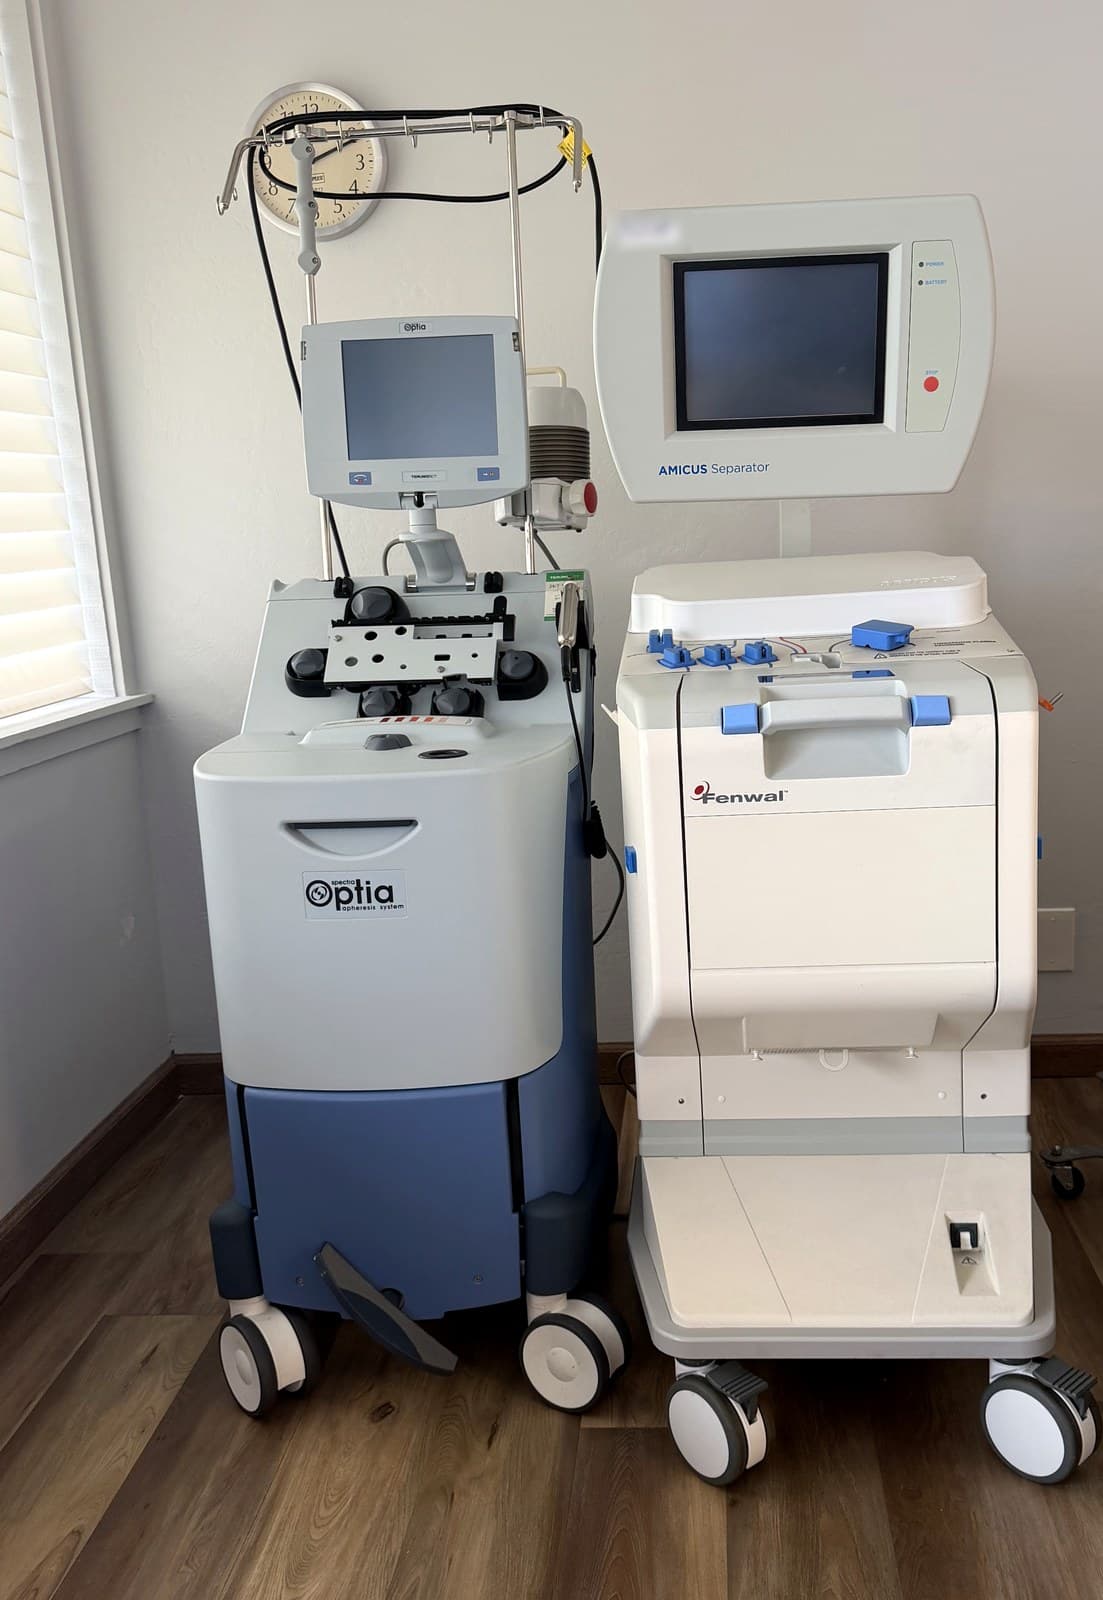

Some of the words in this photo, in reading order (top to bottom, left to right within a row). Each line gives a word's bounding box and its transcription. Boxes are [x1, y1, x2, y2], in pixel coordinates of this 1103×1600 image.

[355, 154, 365, 171] 3
[268, 180, 279, 196] 8
[348, 179, 359, 194] 4
[287, 198, 297, 214] 7
[333, 199, 343, 214] 5
[404, 323, 426, 333] Optia
[658, 464, 708, 476] AMICUS
[711, 462, 770, 475] Separator
[305, 878, 394, 911] Optia
